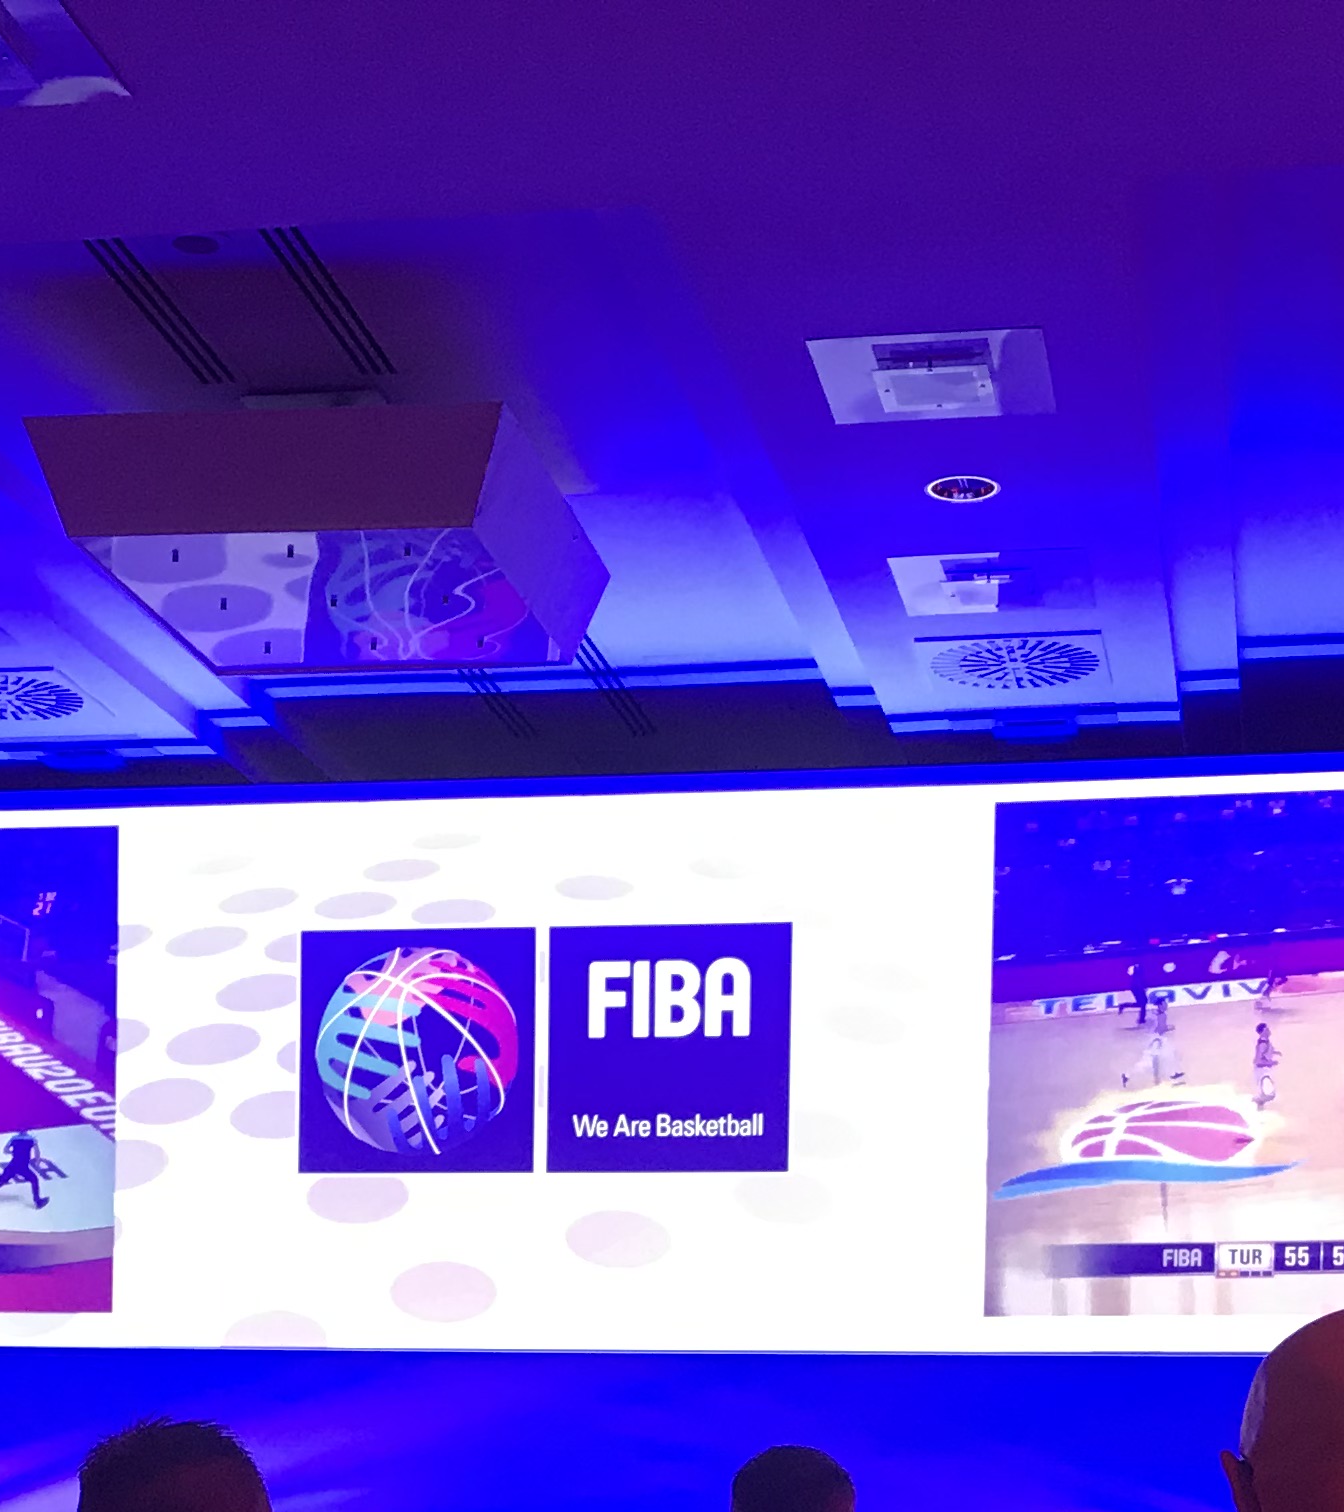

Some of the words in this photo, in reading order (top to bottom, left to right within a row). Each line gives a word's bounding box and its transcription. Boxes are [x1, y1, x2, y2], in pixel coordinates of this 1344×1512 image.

[587, 956, 752, 1039] FIBA
[571, 1113, 609, 1138] We
[612, 1113, 652, 1138] Are
[655, 1112, 765, 1138] Basketball
[1162, 1248, 1203, 1268] FIBA
[1228, 1248, 1264, 1266] TUR
[1283, 1246, 1311, 1267] 55
